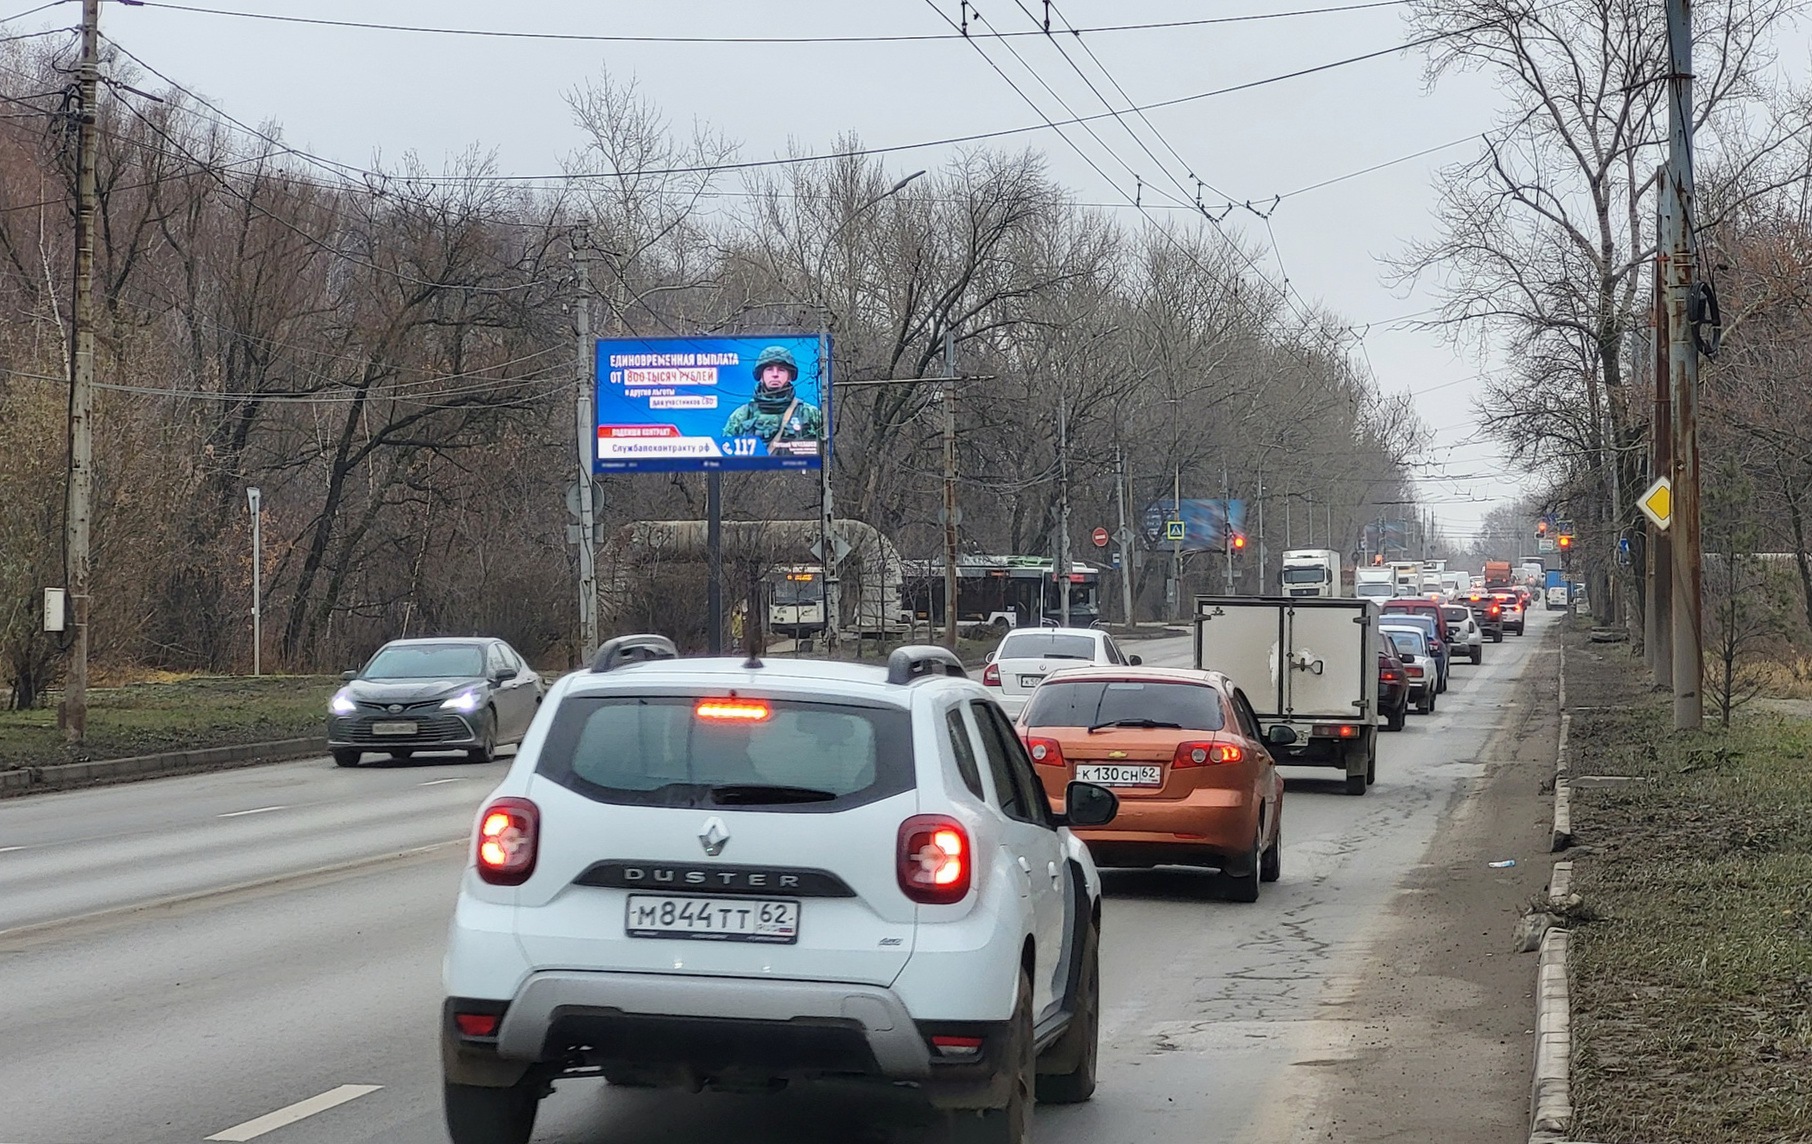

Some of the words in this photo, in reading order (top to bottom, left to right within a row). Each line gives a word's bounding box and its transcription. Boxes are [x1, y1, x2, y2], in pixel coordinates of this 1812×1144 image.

[609, 354, 695, 367] ЕДИНОВРЕМЕННАЯ
[697, 353, 739, 365] ВЫПЛАТА
[610, 371, 622, 383] ОТ
[627, 371, 645, 382] 800
[647, 371, 677, 382] ТЫСЯЧ
[680, 368, 714, 382] РУБЛЕЙ
[734, 438, 756, 455] 117
[1141, 767, 1156, 778] 62
[624, 867, 800, 888] DUSTER
[637, 901, 751, 929] М844ТТ
[759, 903, 788, 924] 62
